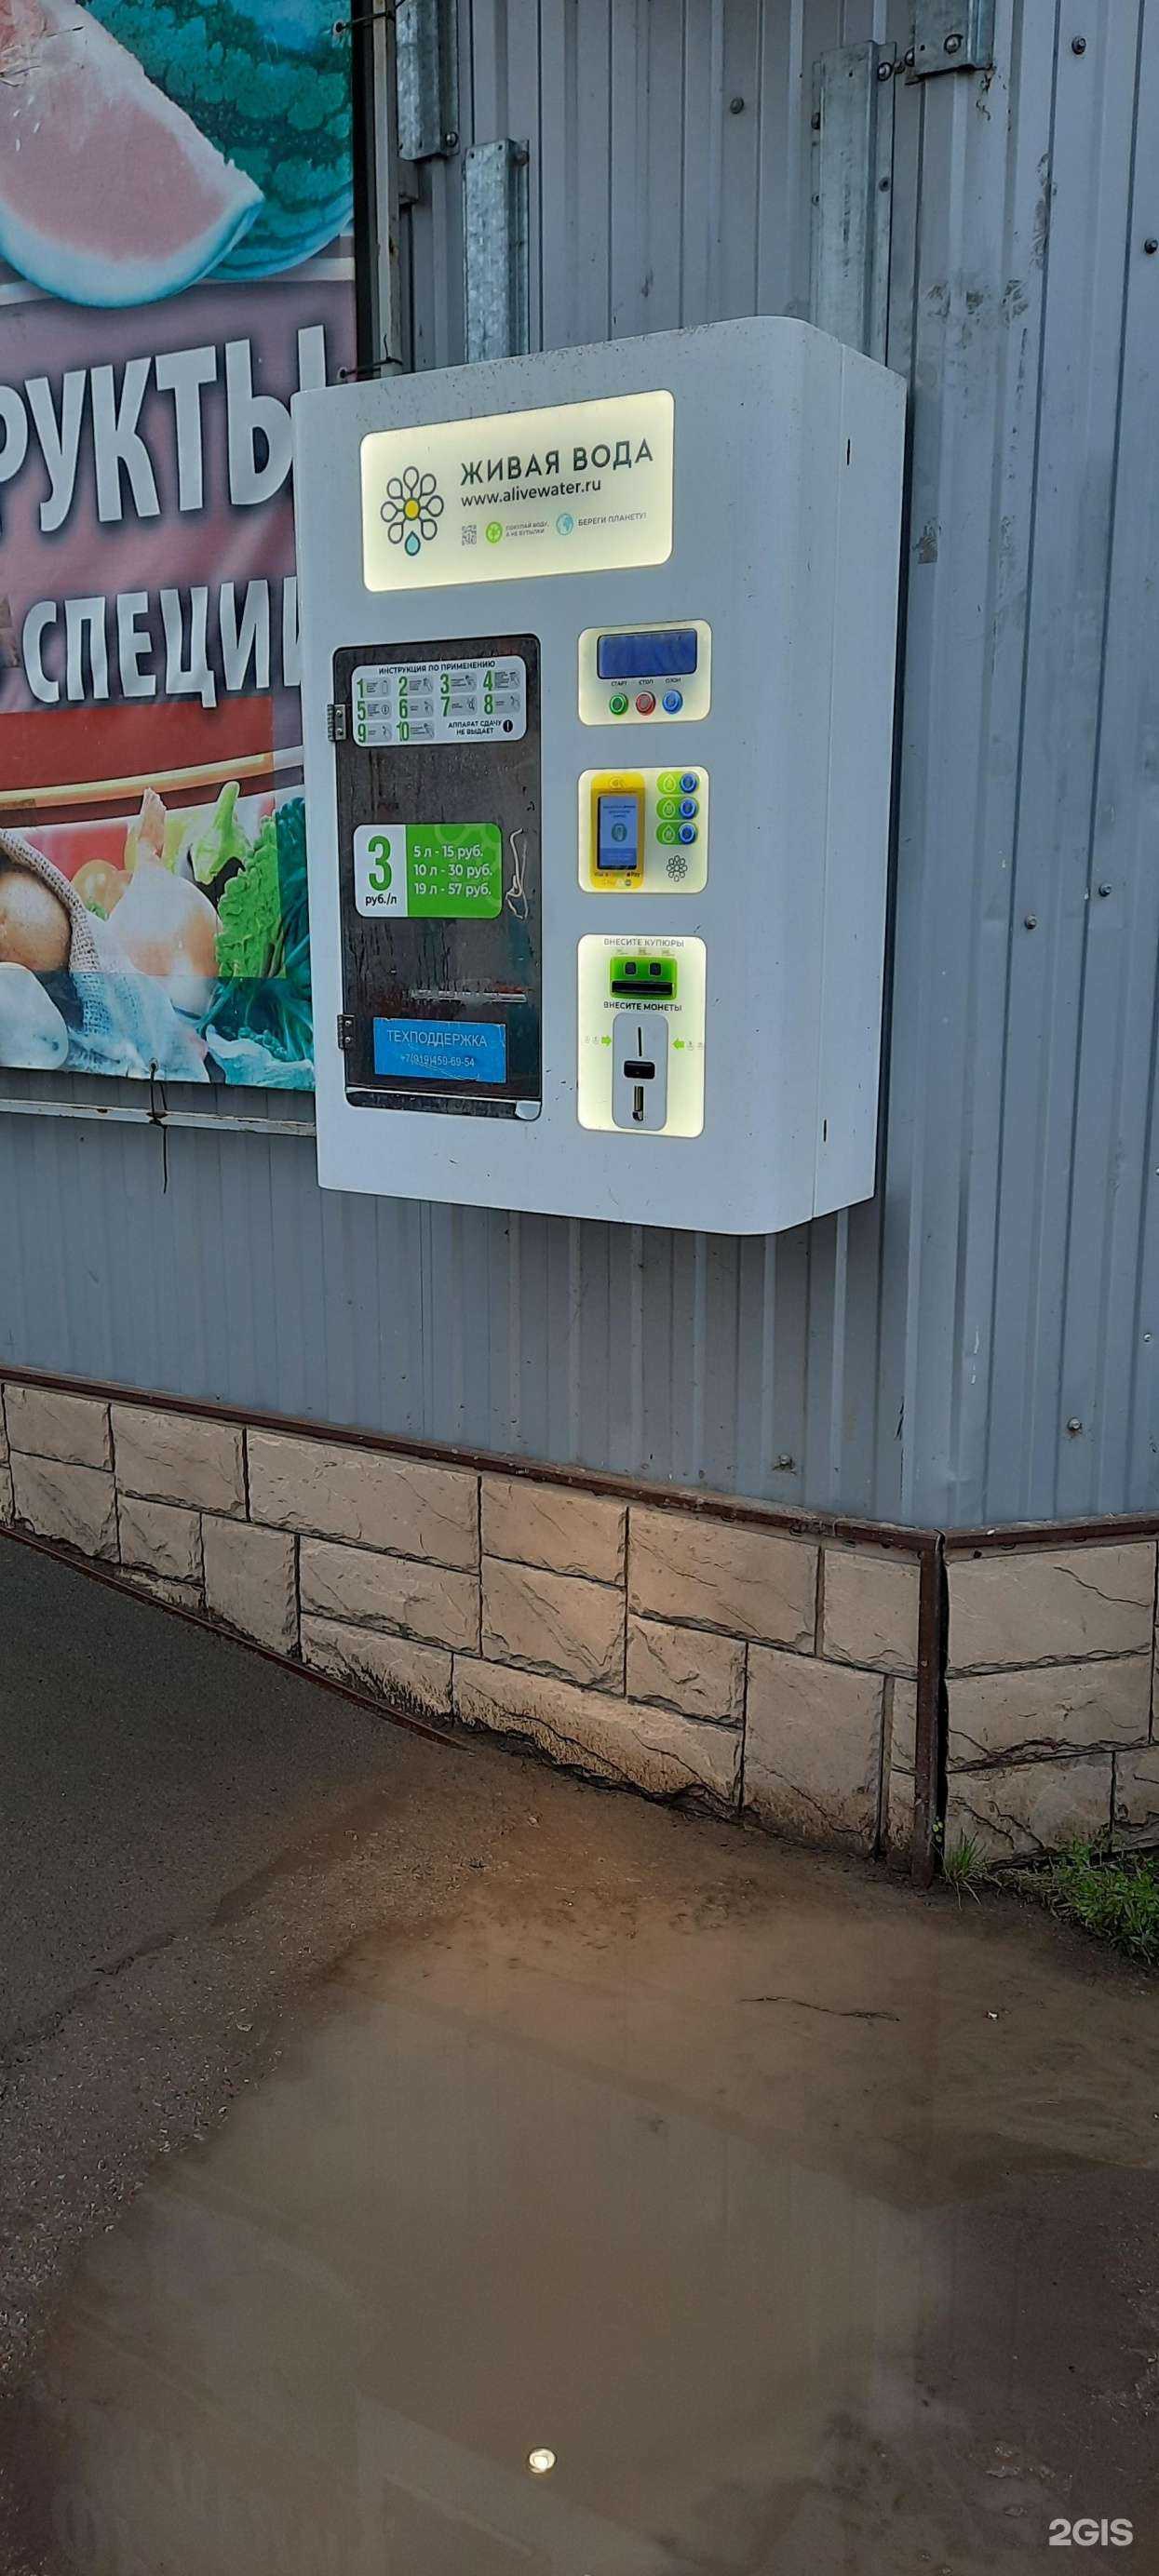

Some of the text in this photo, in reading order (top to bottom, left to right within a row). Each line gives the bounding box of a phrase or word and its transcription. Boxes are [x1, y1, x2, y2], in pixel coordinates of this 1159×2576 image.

[460, 438, 654, 486] ЖИВАЯ ВОДА
[461, 477, 602, 507] www.alivewater.ru
[578, 517, 607, 527] БЕРЕГИ
[379, 660, 496, 675] ИНСТРУКЦИЯ ПО ПРИМЕНЕНИЮ
[357, 678, 364, 698] 1
[398, 676, 408, 696] 2
[440, 673, 450, 694] 3
[483, 670, 493, 691] 4
[357, 701, 366, 720] 5
[398, 699, 409, 718] 6
[440, 696, 451, 717] 7
[483, 694, 493, 715] 8
[357, 723, 366, 743] 9
[396, 721, 410, 742] 10
[448, 720, 478, 729] АППАРАТ
[413, 847, 421, 857] 5
[424, 849, 432, 857] л
[442, 846, 453, 857] 15
[457, 845, 484, 860] руб.
[368, 835, 393, 892] 3
[414, 865, 426, 876] 10
[429, 866, 438, 876] л
[448, 865, 464, 876] 30
[466, 864, 492, 879] руб.
[414, 883, 426, 894] 19
[429, 886, 438, 894] л
[448, 883, 462, 894] 57
[465, 882, 492, 897] руб.
[365, 893, 398, 906] руб./л
[604, 938, 684, 947] ВНЕСИТЕ КУПЮРЫ
[603, 1000, 682, 1012] ВНЕСИТЕ МОНЕТЫ
[386, 1029, 488, 1048] ТЕХПОДДЕРЖКА
